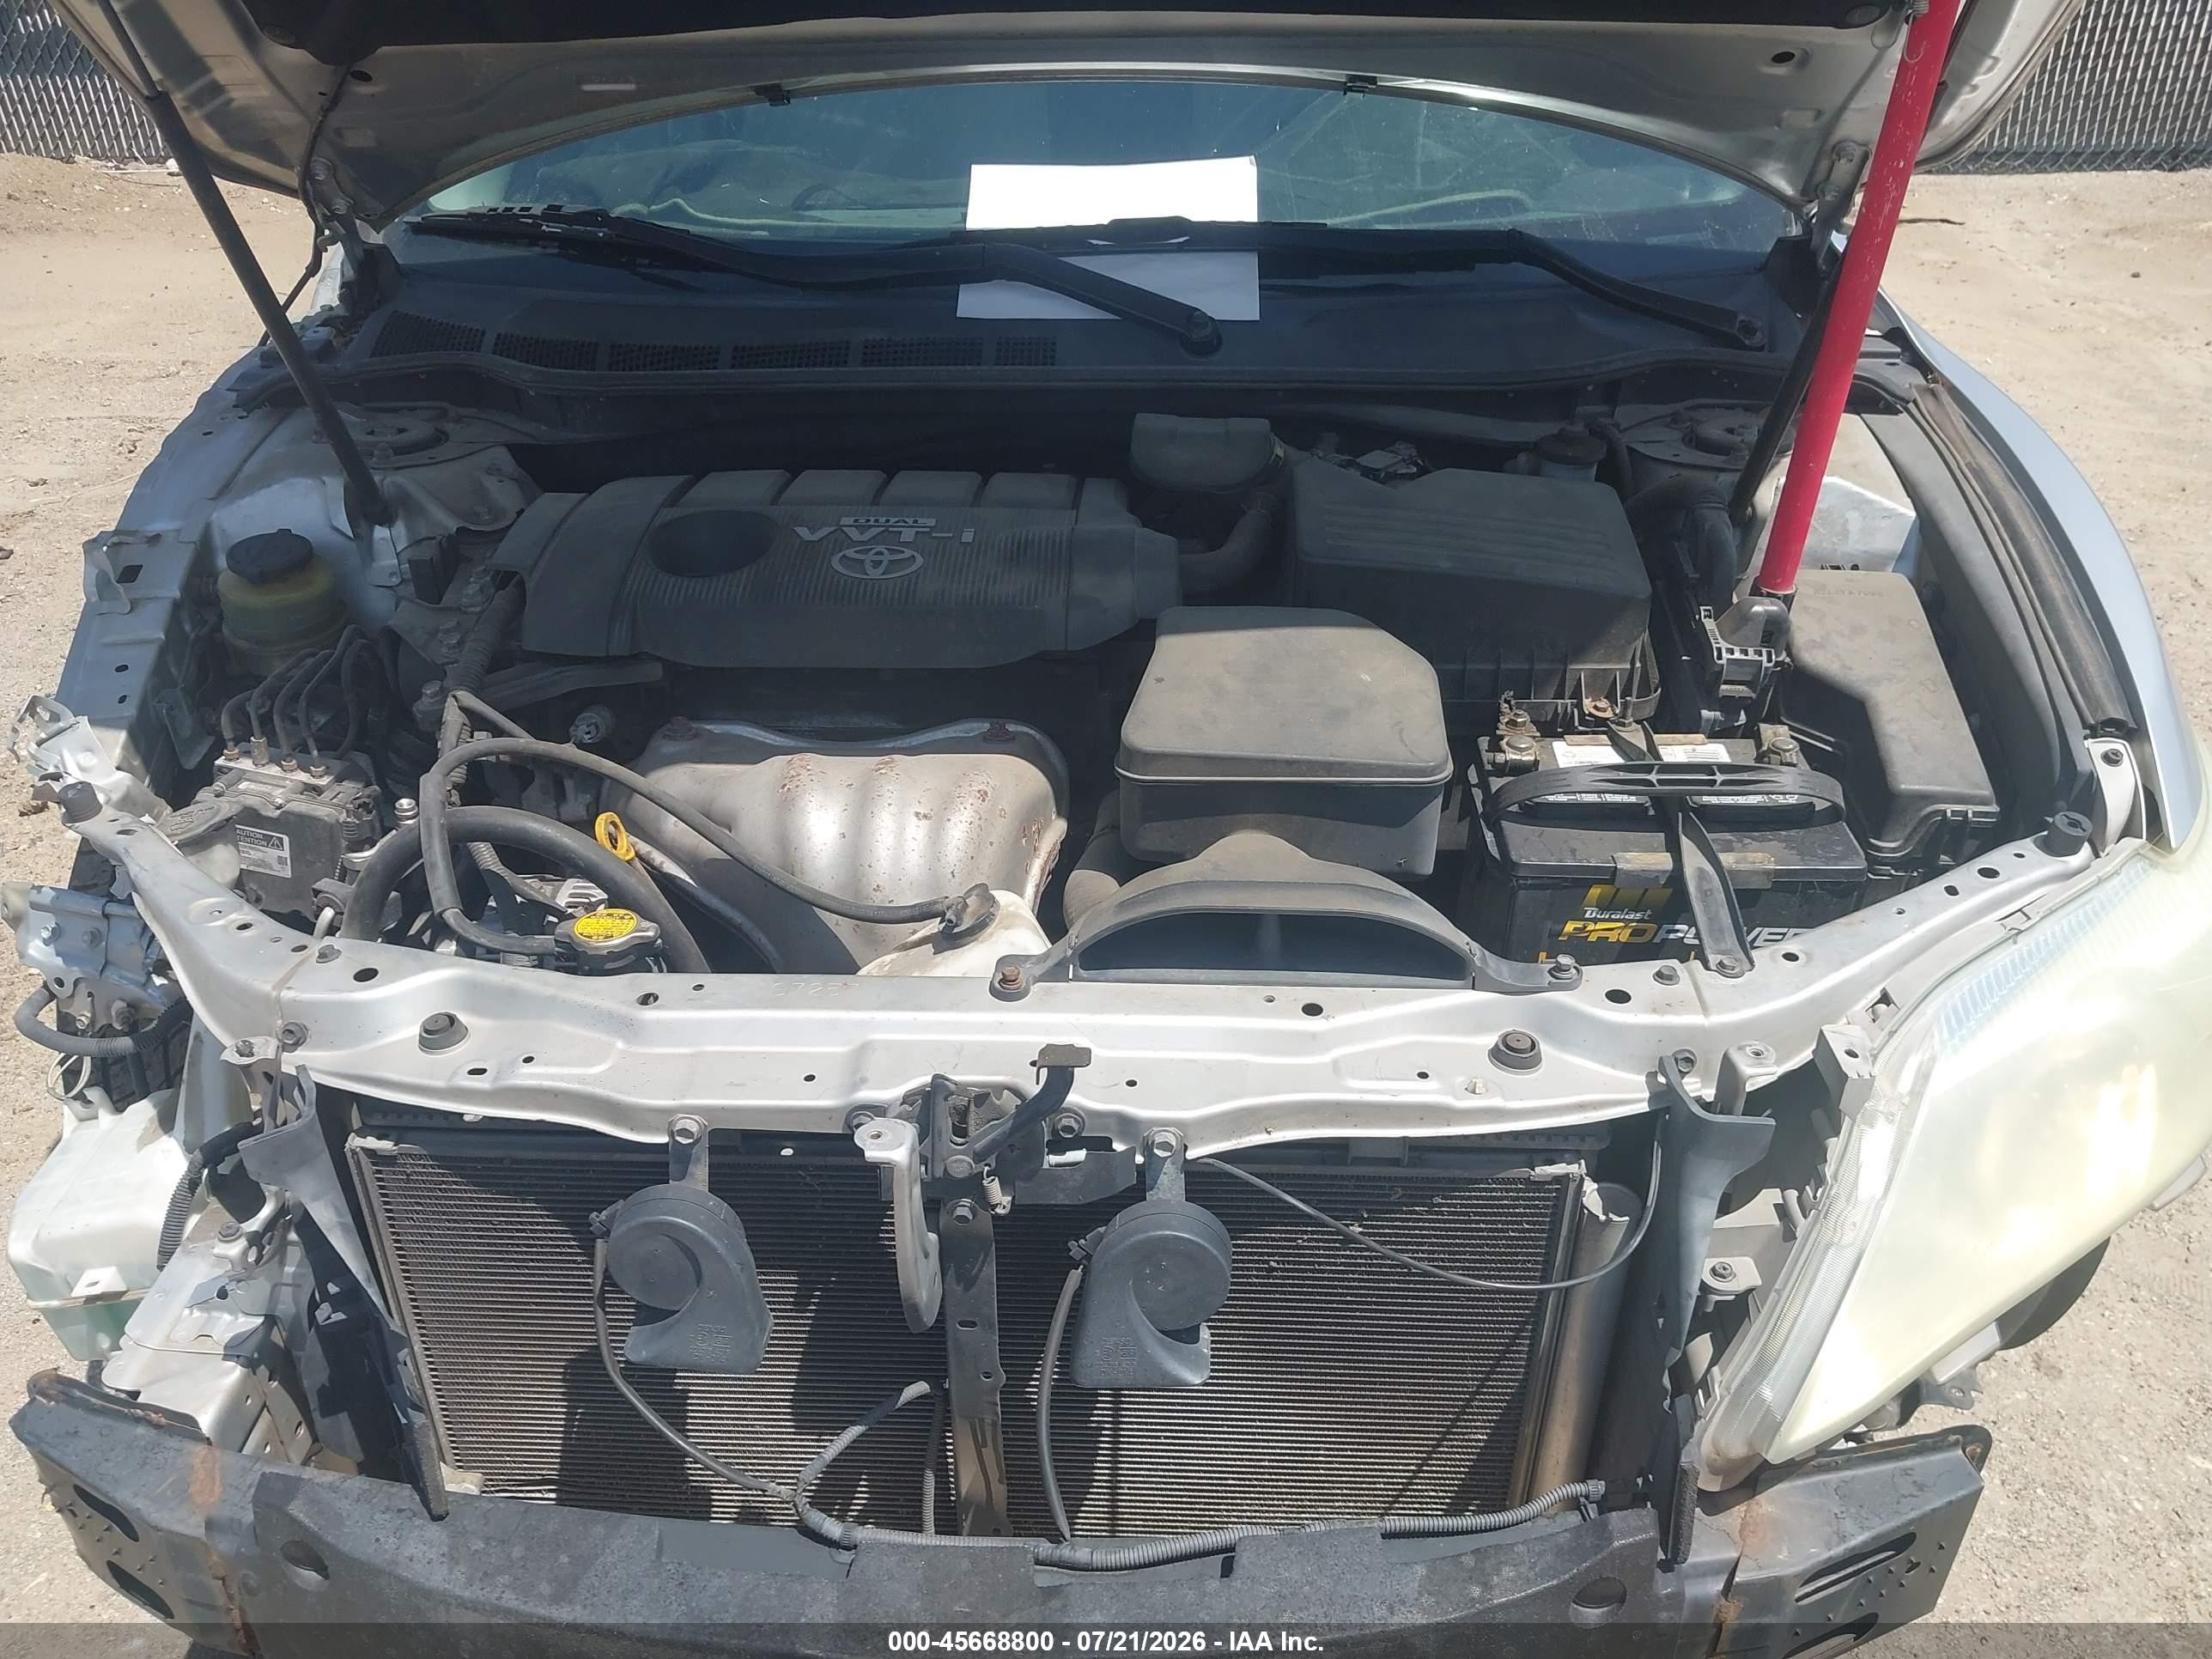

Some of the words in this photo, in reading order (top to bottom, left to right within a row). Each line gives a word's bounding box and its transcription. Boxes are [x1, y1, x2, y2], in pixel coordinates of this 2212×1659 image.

[792, 526, 975, 543] VVT-i
[235, 829, 264, 839] AUTION
[236, 835, 268, 847] TENTION
[1583, 907, 1653, 920] Duralast
[1558, 920, 1815, 947] PROPE
